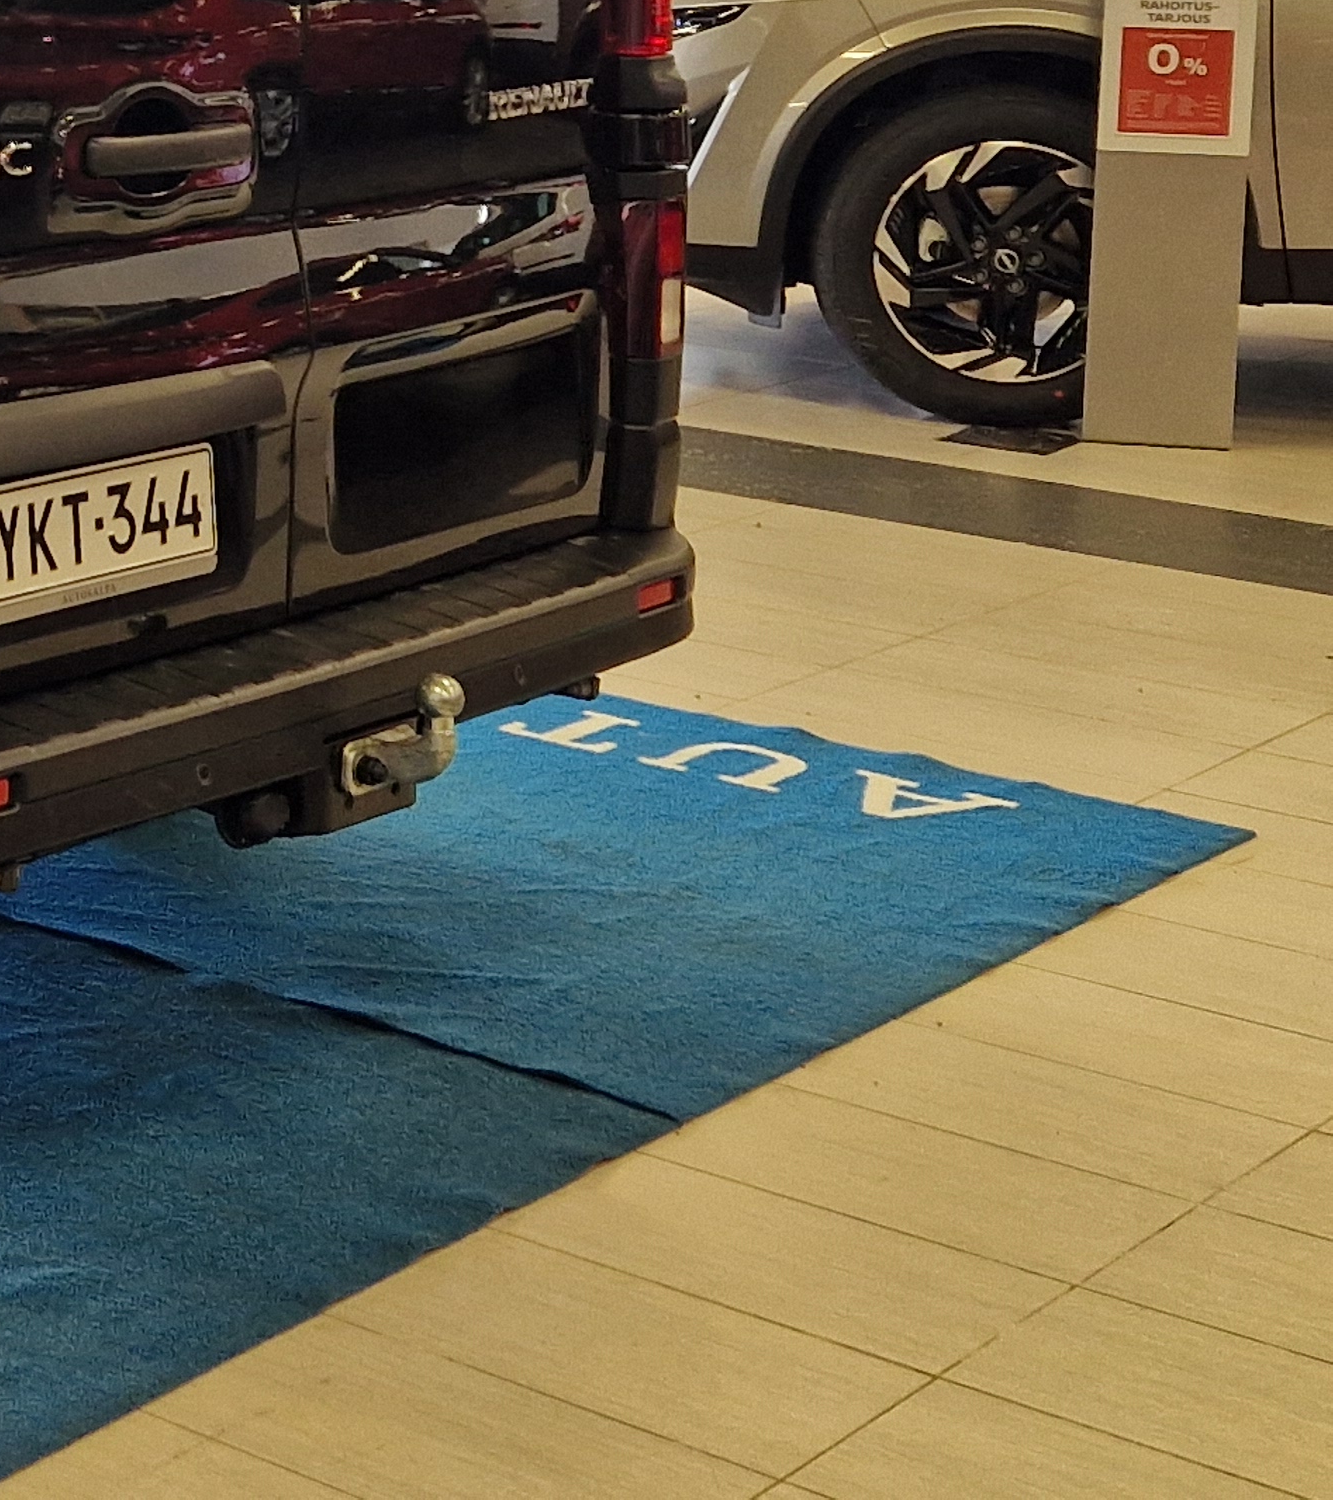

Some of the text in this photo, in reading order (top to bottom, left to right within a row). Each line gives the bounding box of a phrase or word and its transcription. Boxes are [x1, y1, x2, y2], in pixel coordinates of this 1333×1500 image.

[1140, 0, 1220, 11] RAHOITUS-
[1148, 12, 1211, 23] TARJOUS
[488, 77, 594, 121] RENAULT
[498, 710, 1020, 820] AUT
